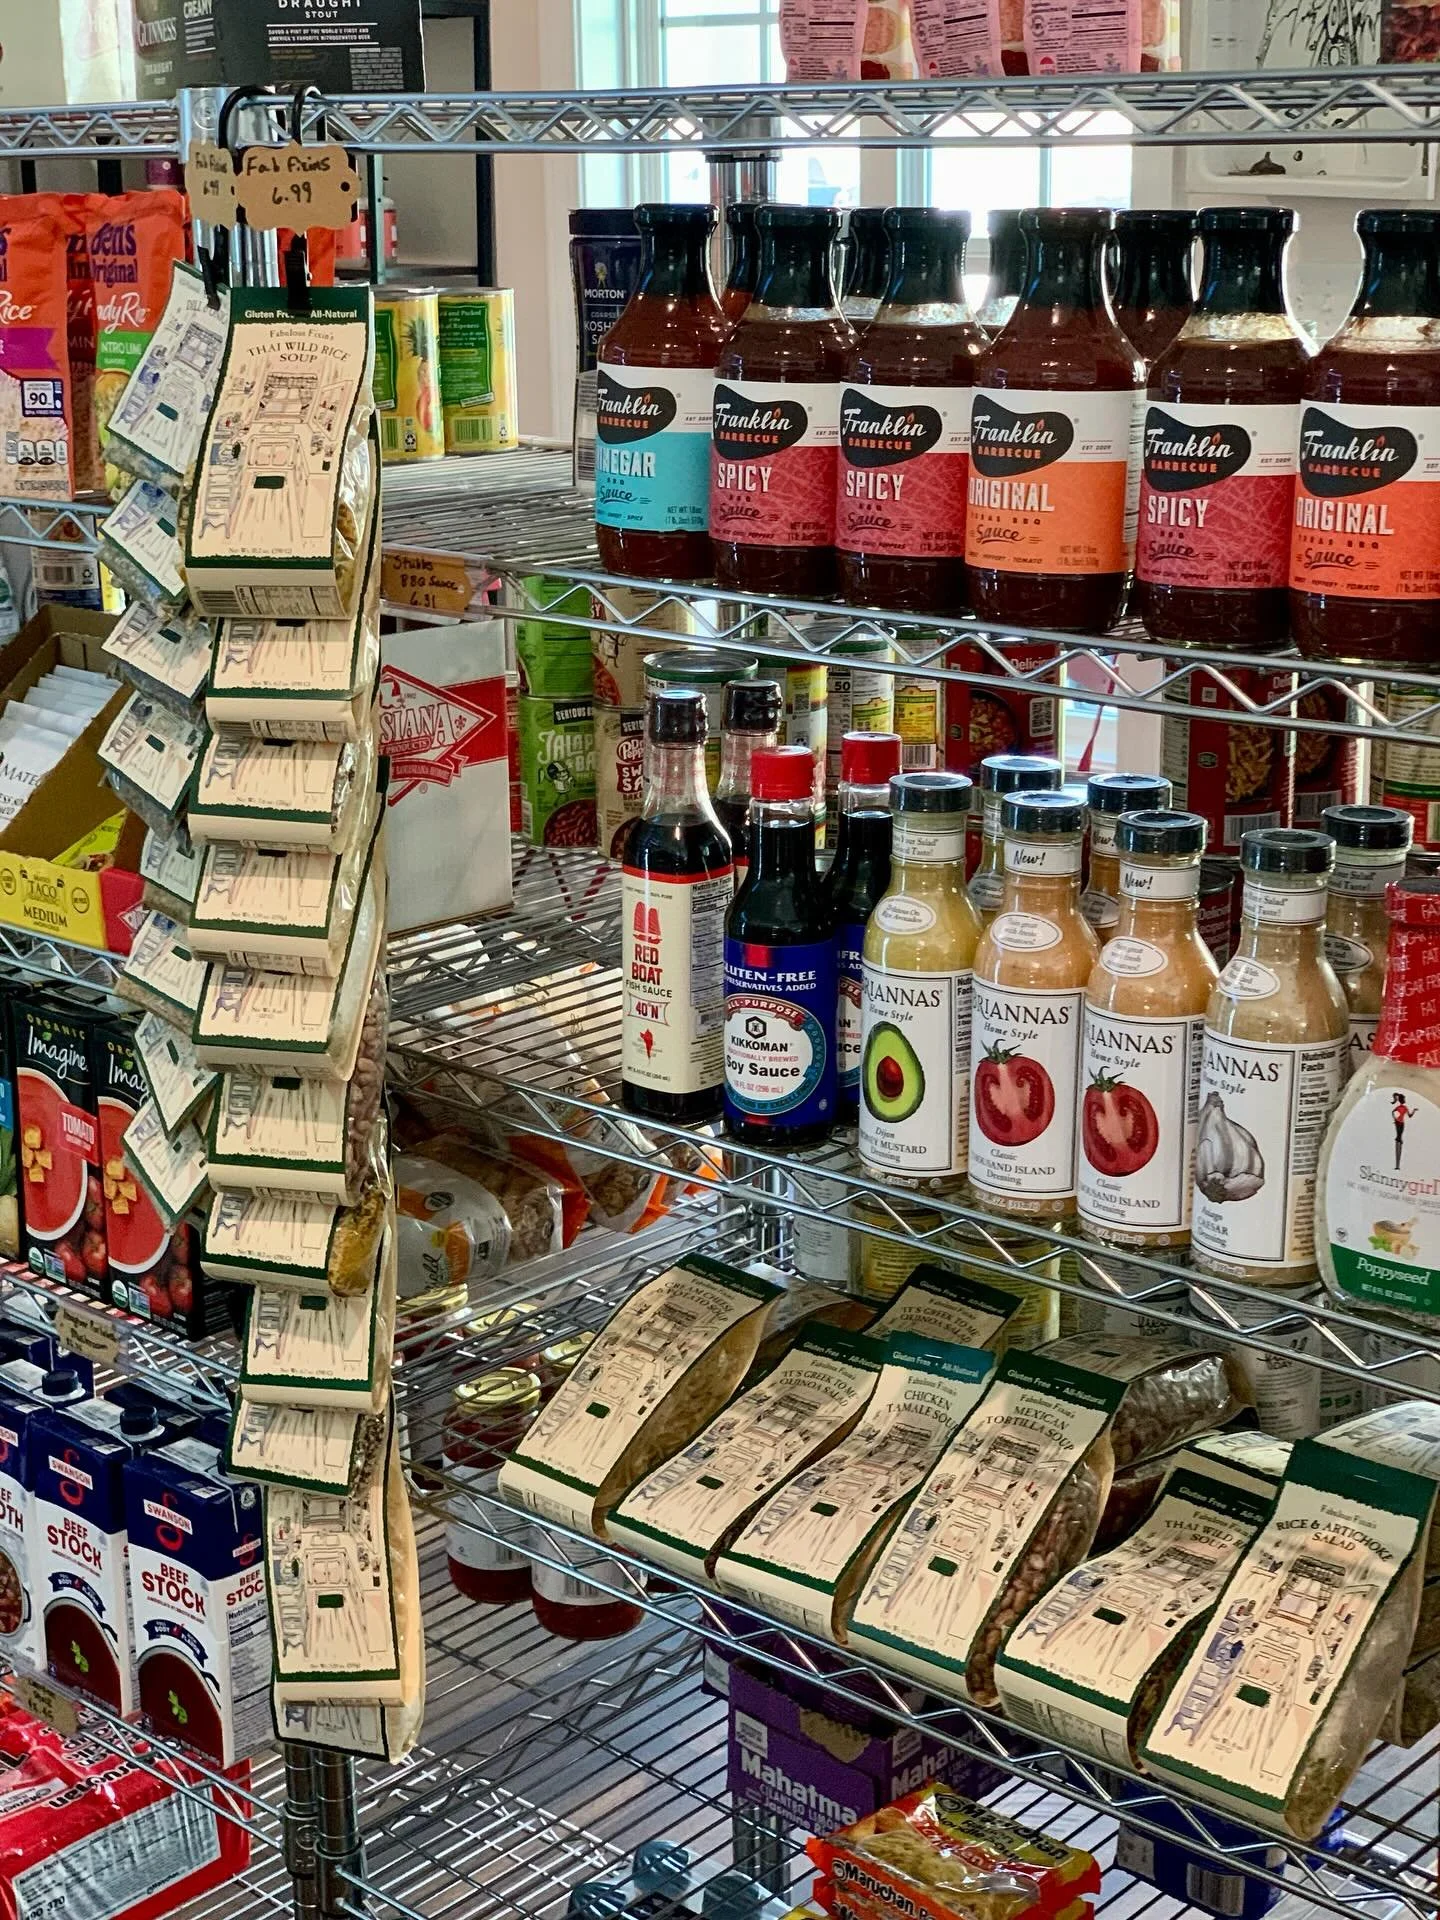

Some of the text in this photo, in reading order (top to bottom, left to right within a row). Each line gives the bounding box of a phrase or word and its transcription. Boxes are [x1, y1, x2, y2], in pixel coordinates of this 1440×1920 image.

[305, 10, 338, 18] STOUT
[138, 17, 177, 47] GUINNESS
[246, 156, 280, 176] Fab
[272, 182, 312, 204] 6.99
[584, 288, 624, 299] MORTON
[245, 310, 358, 318] Gluten All-Natural
[248, 341, 351, 362] THAI WILD RICE
[280, 353, 318, 363] SOUP
[30, 392, 48, 406] 90
[598, 388, 663, 417] Franklin
[599, 416, 650, 429] BARBECUE
[714, 402, 793, 431] Franklin
[842, 408, 927, 437] Franklin
[720, 430, 780, 444] BARBECUE
[972, 414, 1058, 446] Franklin
[848, 437, 912, 450] BARBECUE
[1146, 428, 1234, 458] Franklin
[1302, 430, 1400, 463] Franklin
[597, 447, 656, 478] INEGAR
[978, 446, 1042, 460] BARBECUE
[1151, 459, 1218, 474] BARBECUE
[1308, 463, 1382, 478] BARBECUE
[718, 462, 773, 494] SPICY
[846, 470, 905, 501] SPICY
[600, 485, 638, 503] Sauce
[968, 477, 1055, 512] ORIGINAL
[720, 503, 766, 521] Sauce
[848, 512, 898, 530] Sauce
[1148, 496, 1208, 528] SPICY
[1296, 496, 1394, 536] ORIGINAL
[976, 524, 1026, 544] Sauce
[1150, 541, 1201, 560] Sauce
[1304, 548, 1362, 568] Sauce
[834, 681, 850, 692] 50
[555, 707, 586, 721] SERIOUS
[380, 702, 459, 748] SIANA
[1013, 850, 1046, 866] New!
[28, 880, 56, 899] TACO
[1124, 872, 1154, 890] New!
[24, 905, 68, 928] MEDIUM
[634, 944, 659, 966] RED
[1422, 949, 1440, 966] FAT
[632, 962, 663, 986] BOAT
[725, 964, 816, 983] LUTEN-FREE
[626, 980, 673, 998] FISH SAUCE
[785, 982, 816, 992] ADDED
[864, 978, 941, 1008] RIANNAS
[728, 999, 798, 1018] ALL-PURPOSE
[868, 1004, 914, 1022] Home Style
[973, 996, 1070, 1025] RIANNAS
[1420, 1000, 1437, 1016] FAT
[26, 1014, 86, 1040] ORGANIC
[984, 1022, 1039, 1041] Home Style
[731, 1034, 788, 1052] KIKKOMAN
[28, 1026, 88, 1080] Imagine
[1090, 1051, 1142, 1070] Home Style
[1302, 1050, 1336, 1062] Nutrition
[1417, 1052, 1437, 1067] FAT
[726, 1054, 801, 1078] Soy Sauce
[1206, 1050, 1280, 1082] ANNAS
[1300, 1062, 1325, 1072] Facts
[1220, 1079, 1246, 1094] Style
[62, 1112, 95, 1145] TOMATO
[876, 1127, 894, 1139] Dijon
[880, 1141, 927, 1154] MUSTARD
[990, 1148, 1018, 1161] Classic
[986, 1170, 1022, 1184] Dressing
[1014, 1164, 1056, 1176] ISLAND
[1096, 1177, 1122, 1192] Classic
[1359, 1164, 1440, 1196] Skinnygirl
[1120, 1194, 1161, 1209] ISLAND
[1356, 1256, 1432, 1286] Poppyseed
[893, 1351, 916, 1362] Gluten
[803, 1370, 832, 1385] GREEK
[1007, 1369, 1034, 1383] Gluten
[822, 1386, 849, 1408] SALAD
[904, 1390, 953, 1411] CHICKEN
[886, 1403, 932, 1418] TAMALE
[1014, 1406, 1070, 1430] MEXICAN
[986, 1415, 1075, 1451] TORTILLA SOUP
[50, 1459, 92, 1486] SWANSON
[147, 1504, 191, 1531] SWANSON
[63, 1516, 88, 1539] BEEF
[1165, 1519, 1235, 1544] THAI WILD
[1190, 1533, 1229, 1550] SOUP
[1276, 1518, 1310, 1531] RICE
[1324, 1521, 1394, 1562] ARTICHOKE
[1312, 1532, 1356, 1552] SALAD
[160, 1562, 190, 1586] BEEF
[240, 1570, 261, 1586] BEEF
[141, 1572, 206, 1616] STOCK
[226, 1580, 265, 1606] STOC
[228, 1603, 256, 1620] Nutrition
[154, 1625, 170, 1633] BODY
[741, 1747, 858, 1826] Mahatma
[845, 1861, 914, 1916] Maruchan
